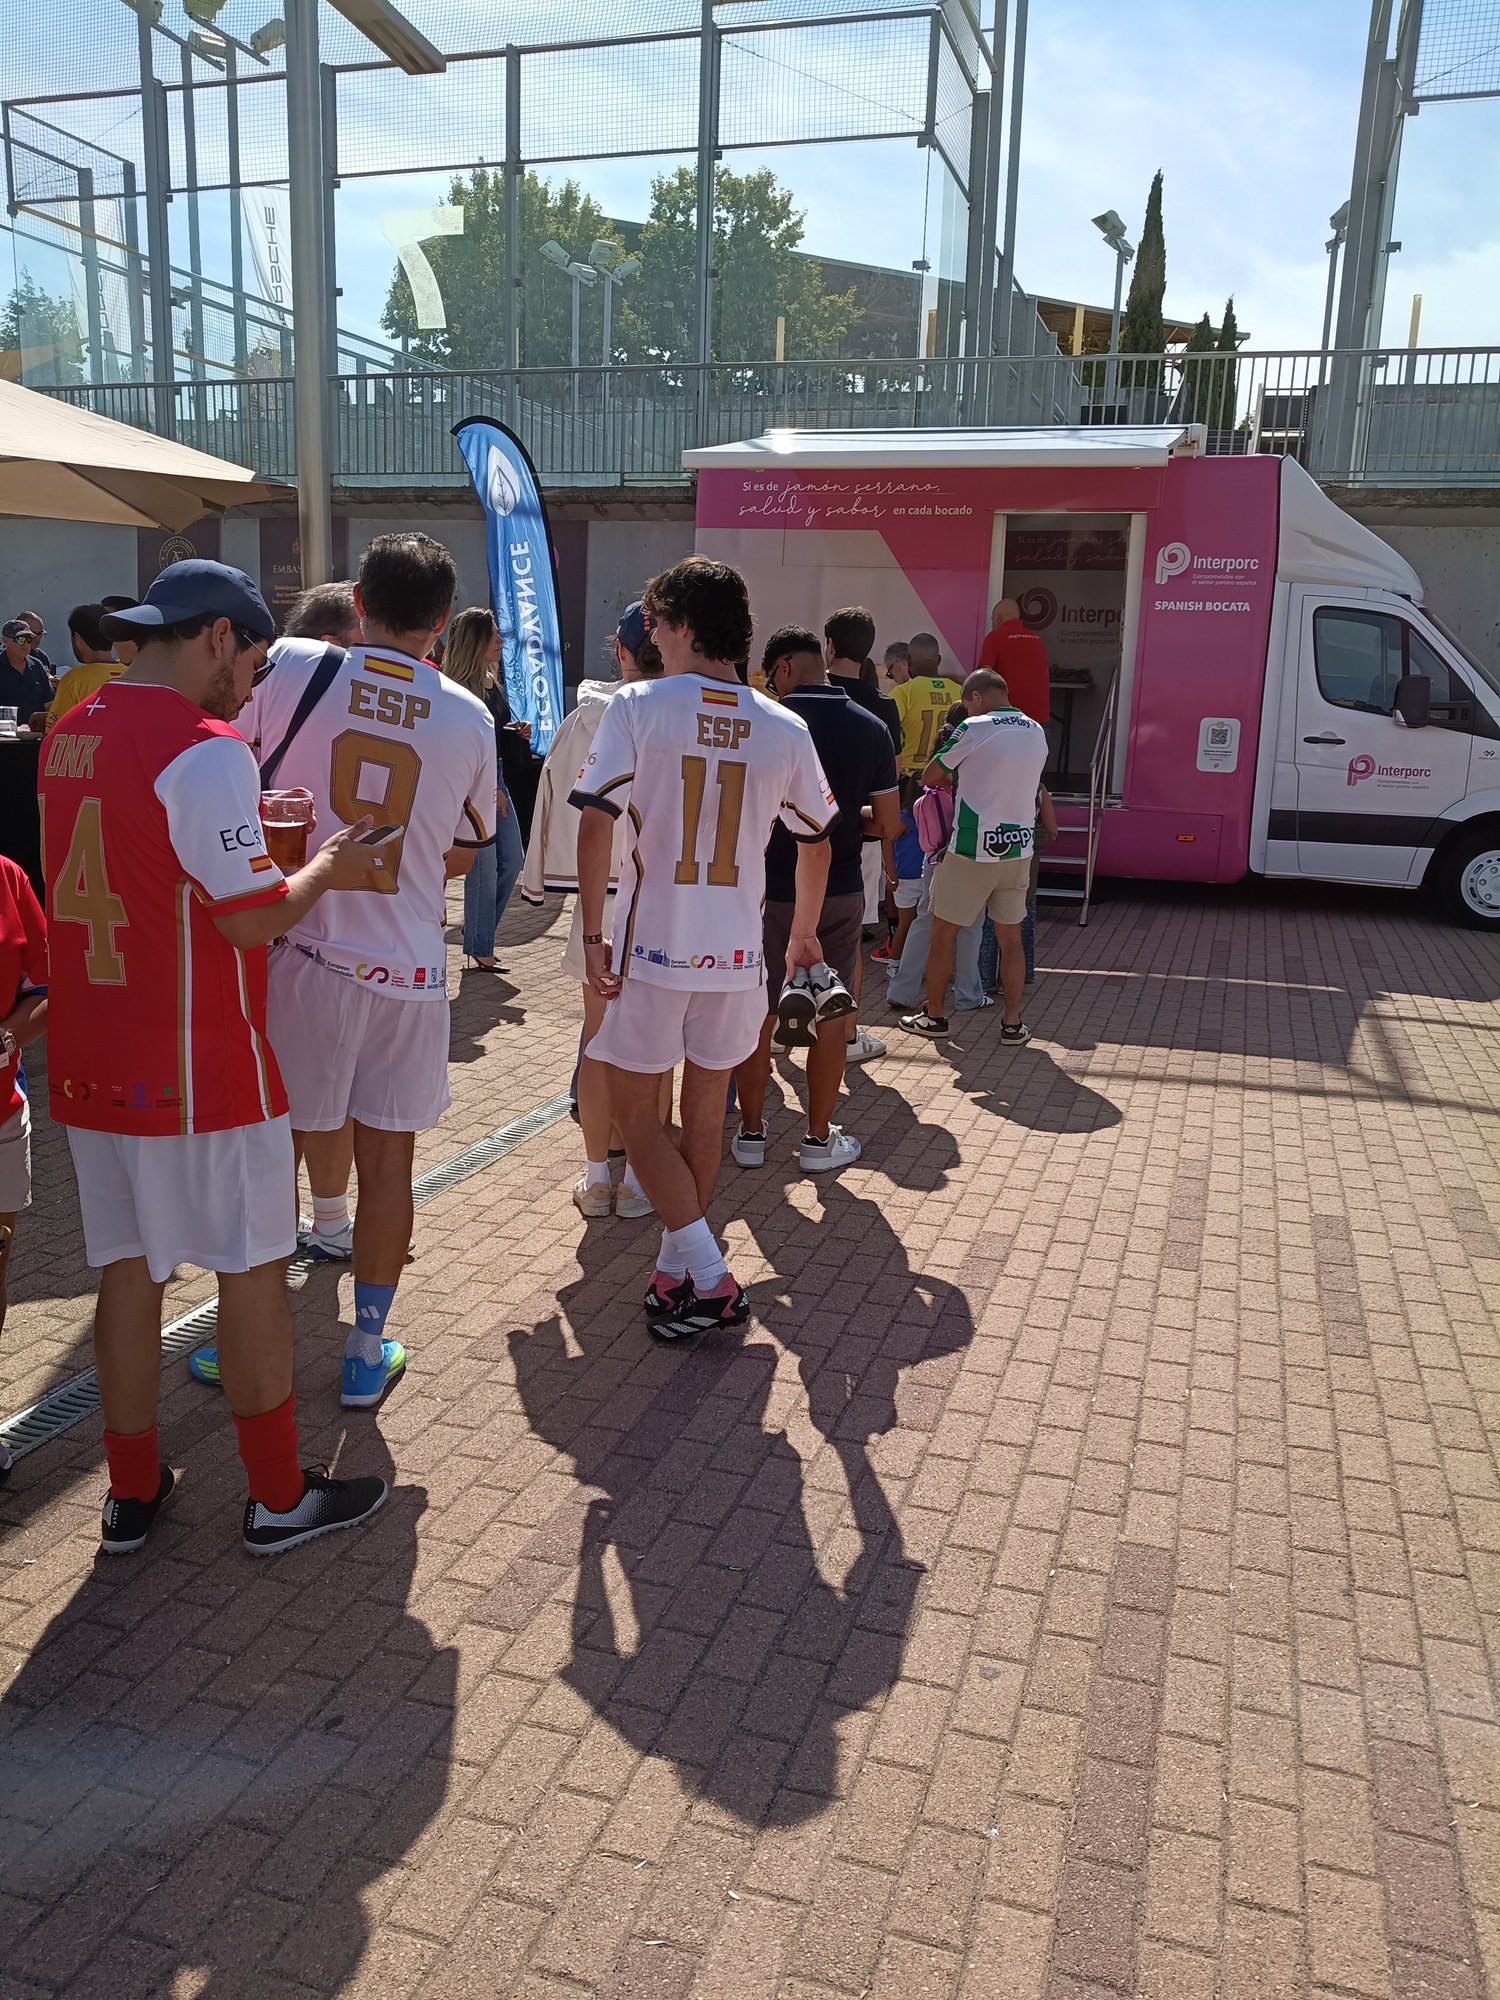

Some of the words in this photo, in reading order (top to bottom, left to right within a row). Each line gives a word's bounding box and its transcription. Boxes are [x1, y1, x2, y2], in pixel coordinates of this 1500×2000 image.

[742, 481, 752, 492] Si
[753, 482, 765, 492] es
[766, 481, 779, 492] de
[778, 479, 850, 502] jamón
[738, 494, 803, 517] salud
[805, 506, 822, 527] y
[825, 496, 887, 518] sabor
[893, 506, 907, 516] en
[908, 504, 933, 516] cada
[934, 504, 974, 516] bocado
[1193, 555, 1260, 573] Interporc
[1062, 604, 1121, 628] Interp
[1154, 600, 1203, 611] SPANISH
[1205, 601, 1251, 612] BOCATA
[348, 679, 431, 730] ESP
[929, 691, 952, 705] BRA
[696, 712, 751, 750] ESP
[992, 716, 1031, 729] BetPlay
[44, 734, 102, 779] DNK
[1378, 765, 1432, 779] Interporc
[674, 754, 747, 888] 11
[983, 826, 1031, 850] picap
[111, 1503, 120, 1529] KIPSTA
